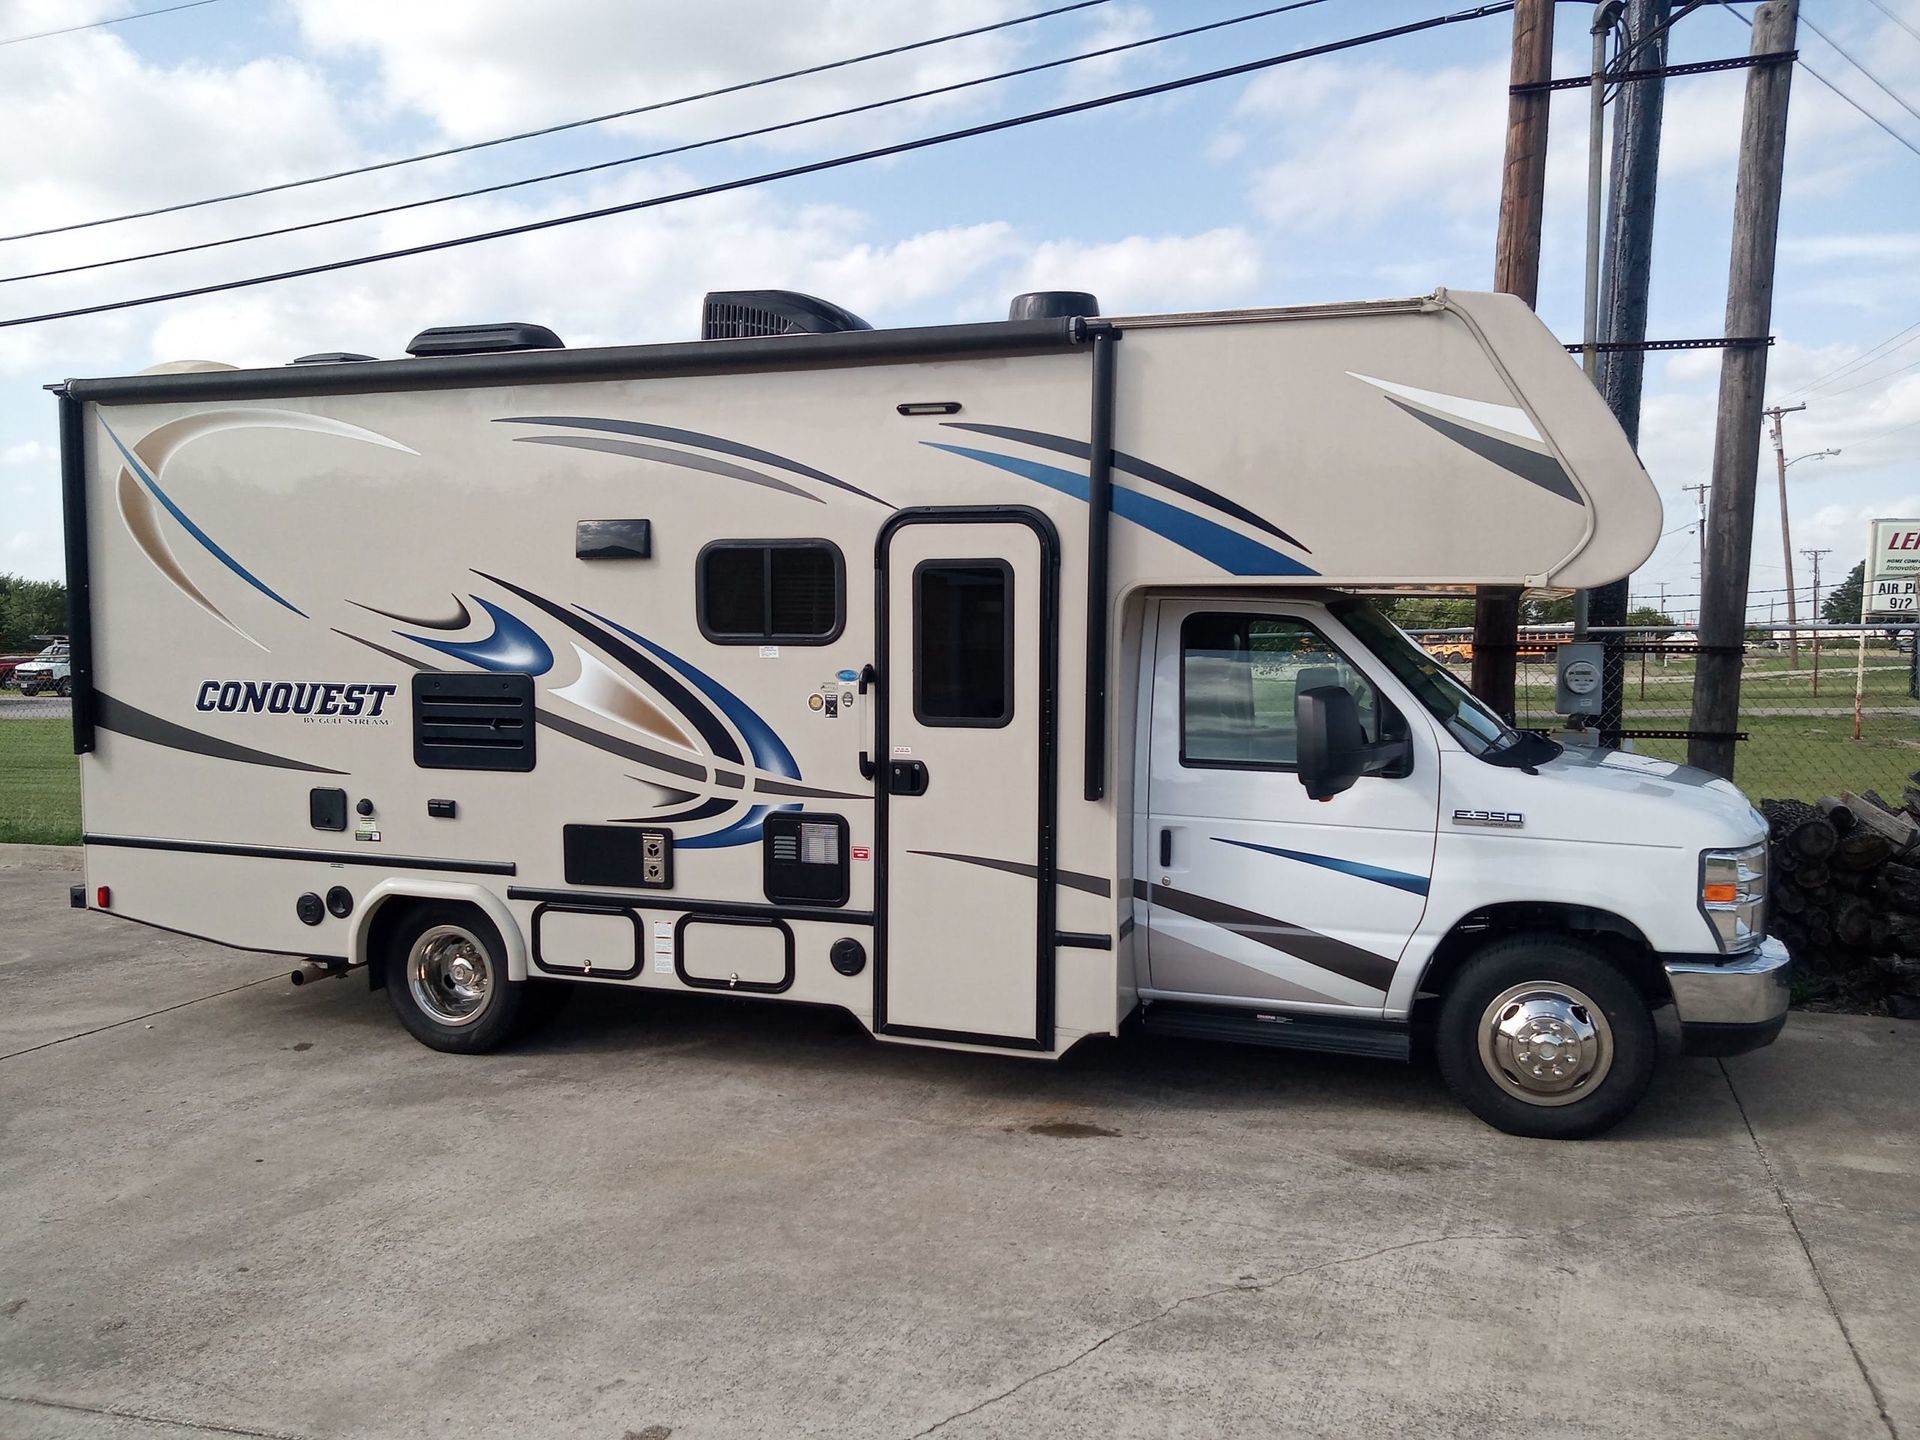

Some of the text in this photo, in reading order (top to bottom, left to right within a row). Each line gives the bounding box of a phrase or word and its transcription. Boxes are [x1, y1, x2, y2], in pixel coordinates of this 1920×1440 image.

[1879, 582, 1899, 594] AIR
[1890, 597, 1913, 609] 972
[195, 679, 399, 718] CONQUEST
[318, 717, 342, 725] GULF
[347, 718, 390, 726] STREAM
[1454, 809, 1524, 823] E-350
